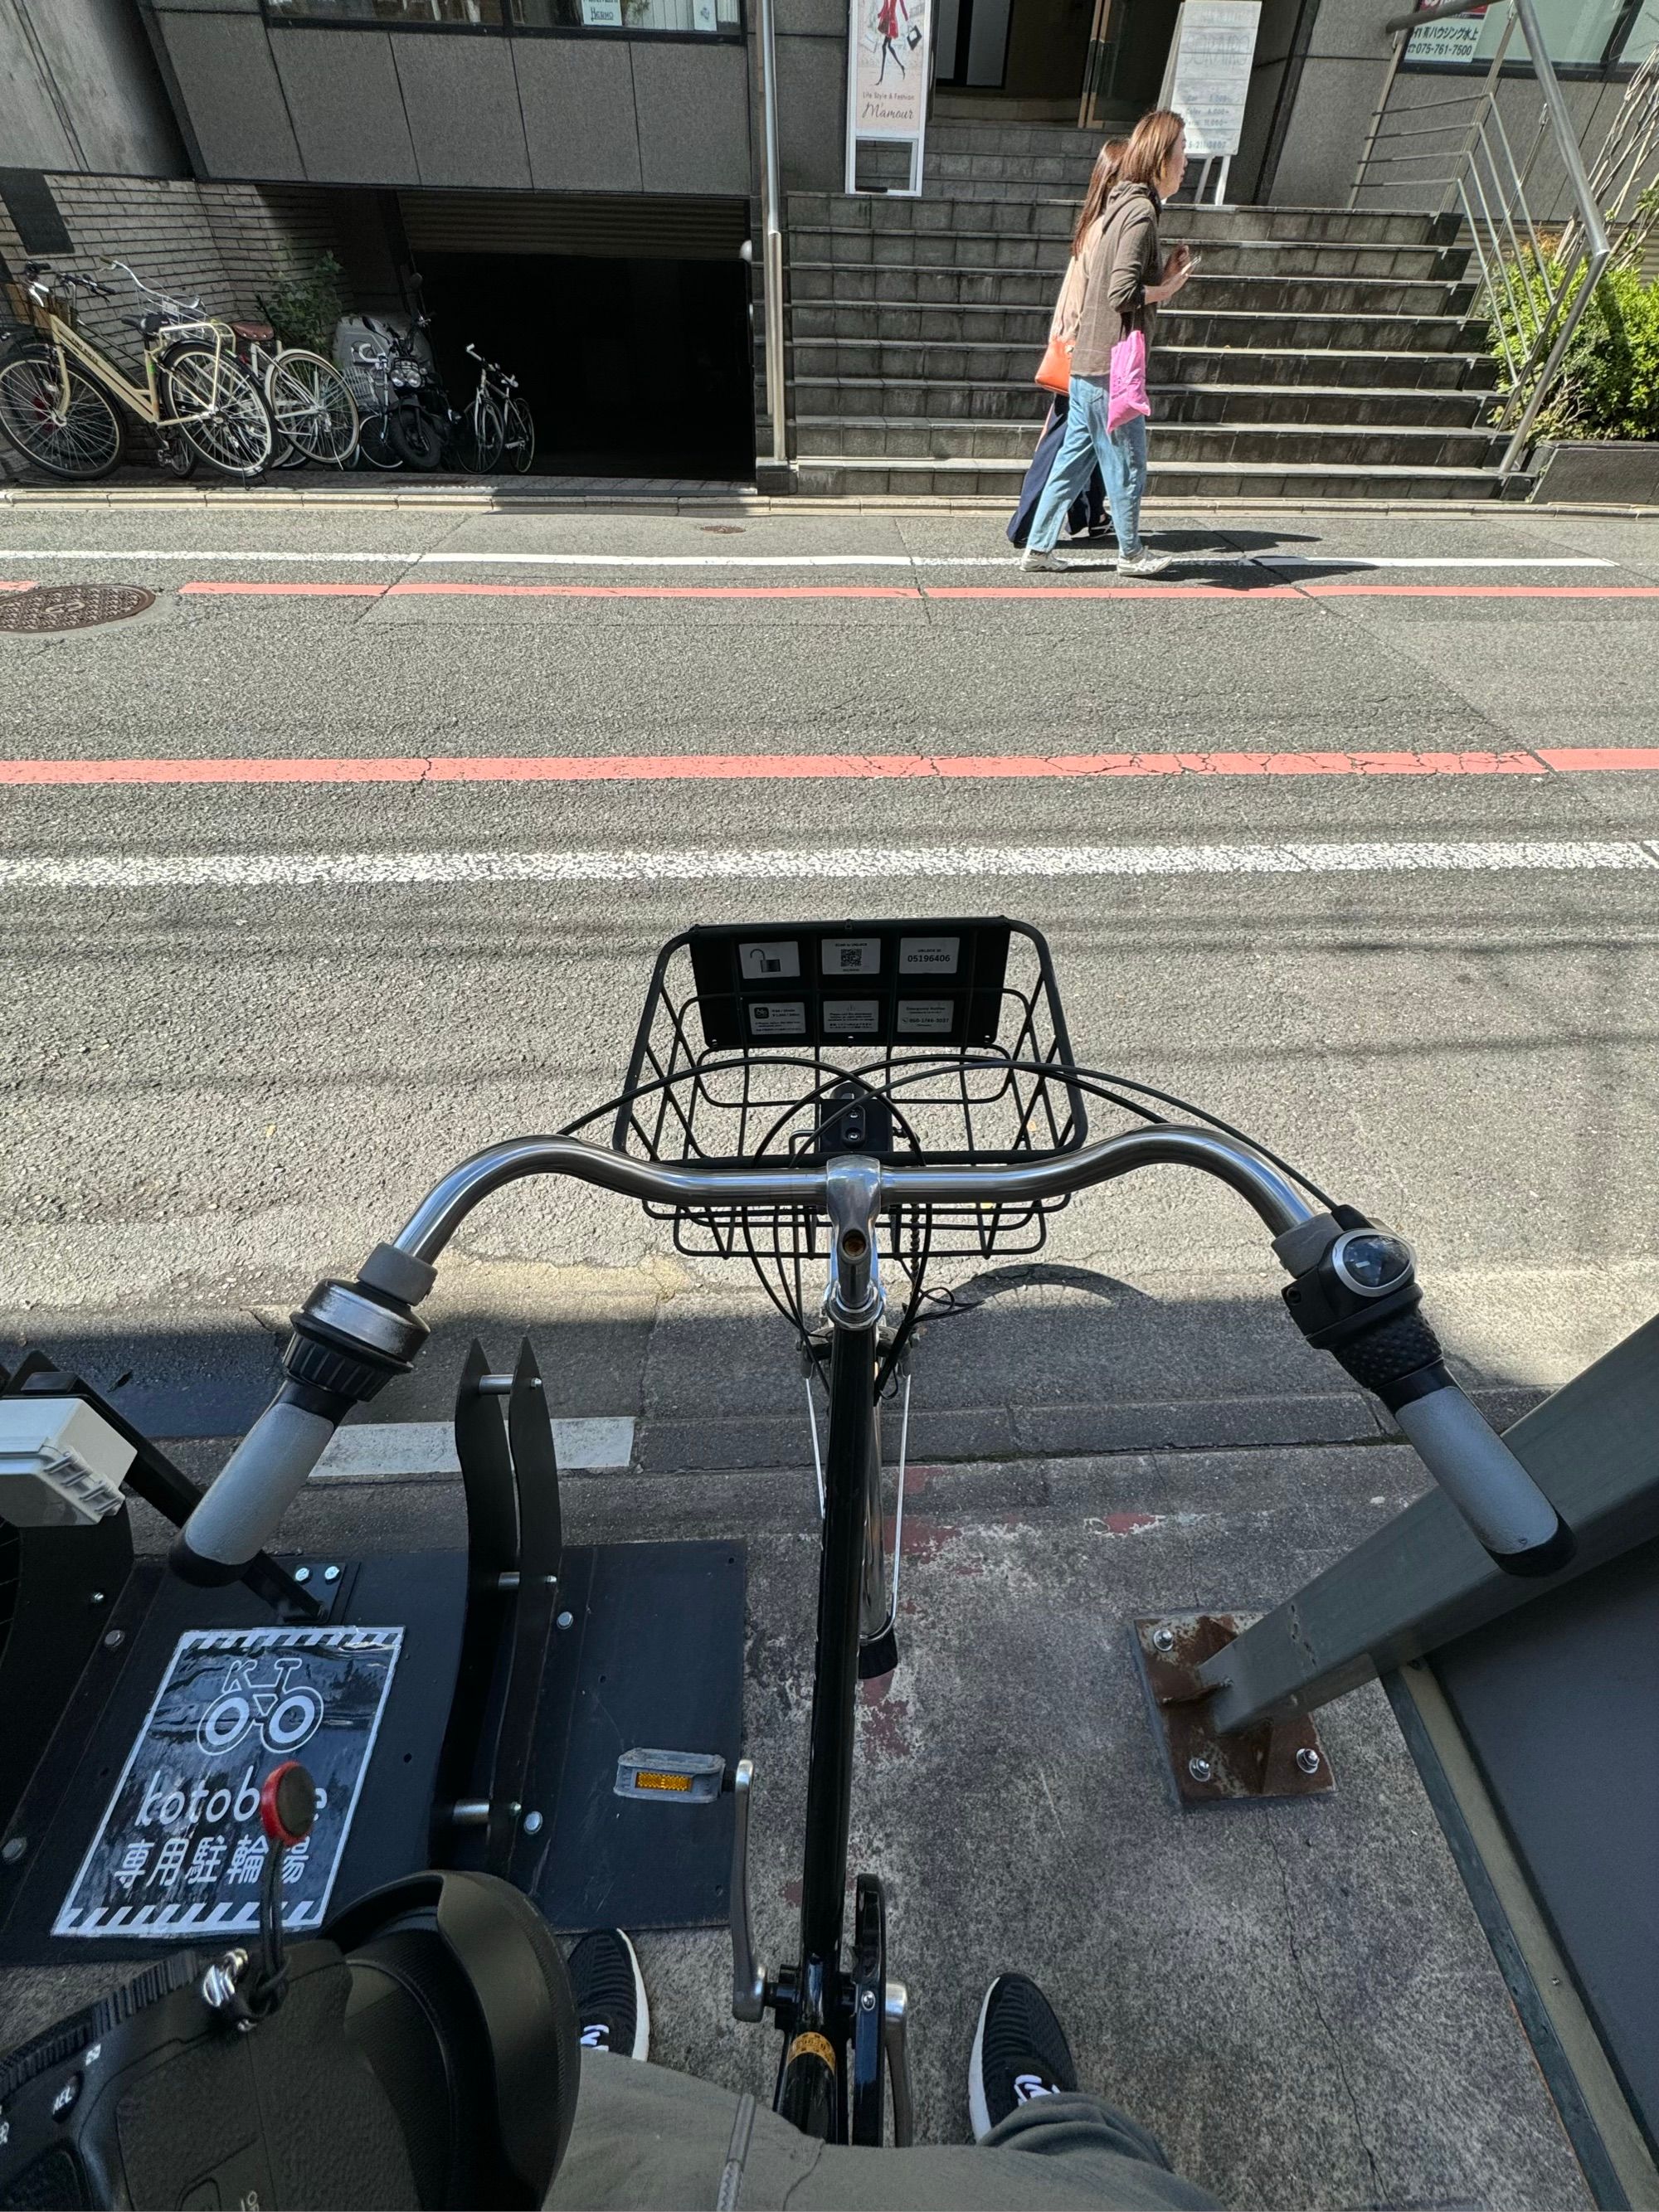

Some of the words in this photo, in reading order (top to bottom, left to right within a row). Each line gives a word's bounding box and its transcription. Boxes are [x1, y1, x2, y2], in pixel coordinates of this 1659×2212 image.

[873, 91, 888, 100] Style
[907, 955, 951, 963] 05196406
[134, 1766, 328, 1827] kotobe
